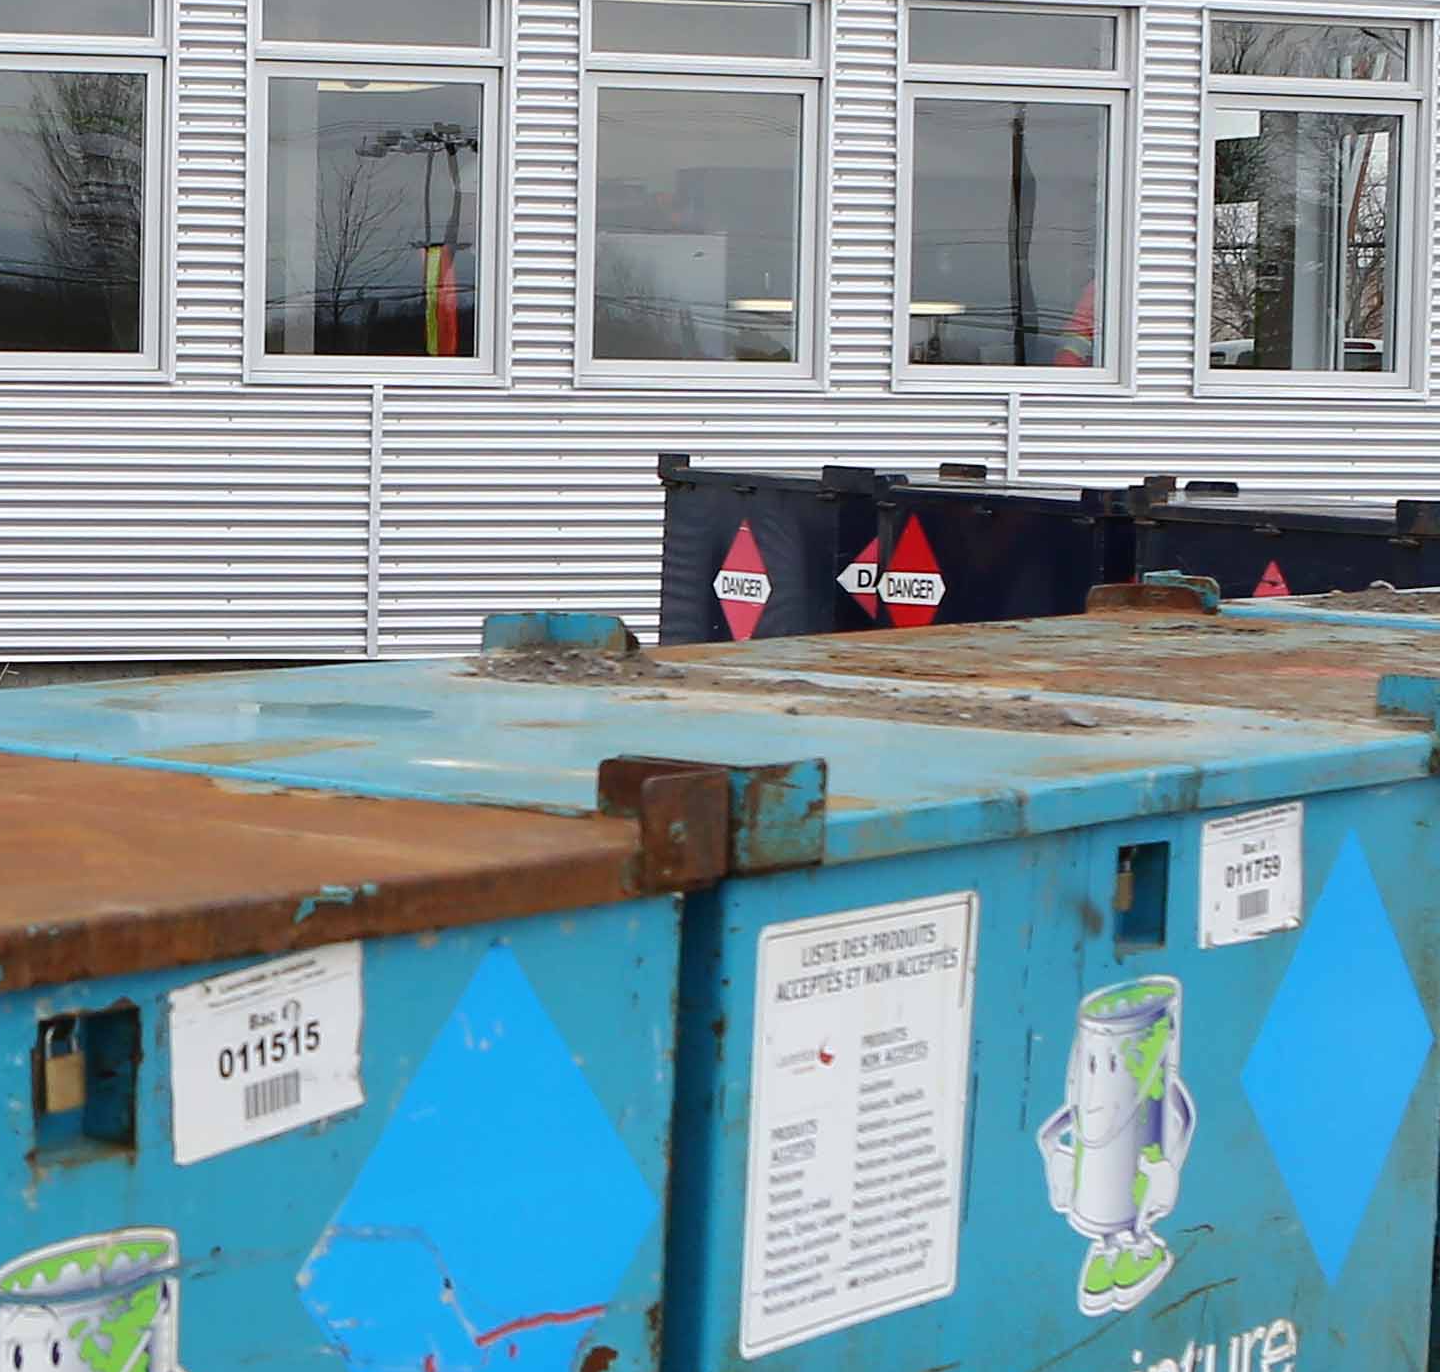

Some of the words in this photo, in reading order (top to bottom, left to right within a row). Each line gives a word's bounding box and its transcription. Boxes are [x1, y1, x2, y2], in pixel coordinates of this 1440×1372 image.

[722, 576, 762, 598] DANGER
[887, 578, 934, 600] DANGER
[802, 941, 839, 968] LISTE
[842, 935, 868, 959] DES
[872, 923, 936, 954] PRODUITS
[776, 967, 842, 1001] ACCEPTÉS
[846, 967, 861, 989] ET
[865, 961, 892, 984] NON
[896, 943, 959, 977] ACCEPTÉS
[219, 1020, 321, 1079] 011515
